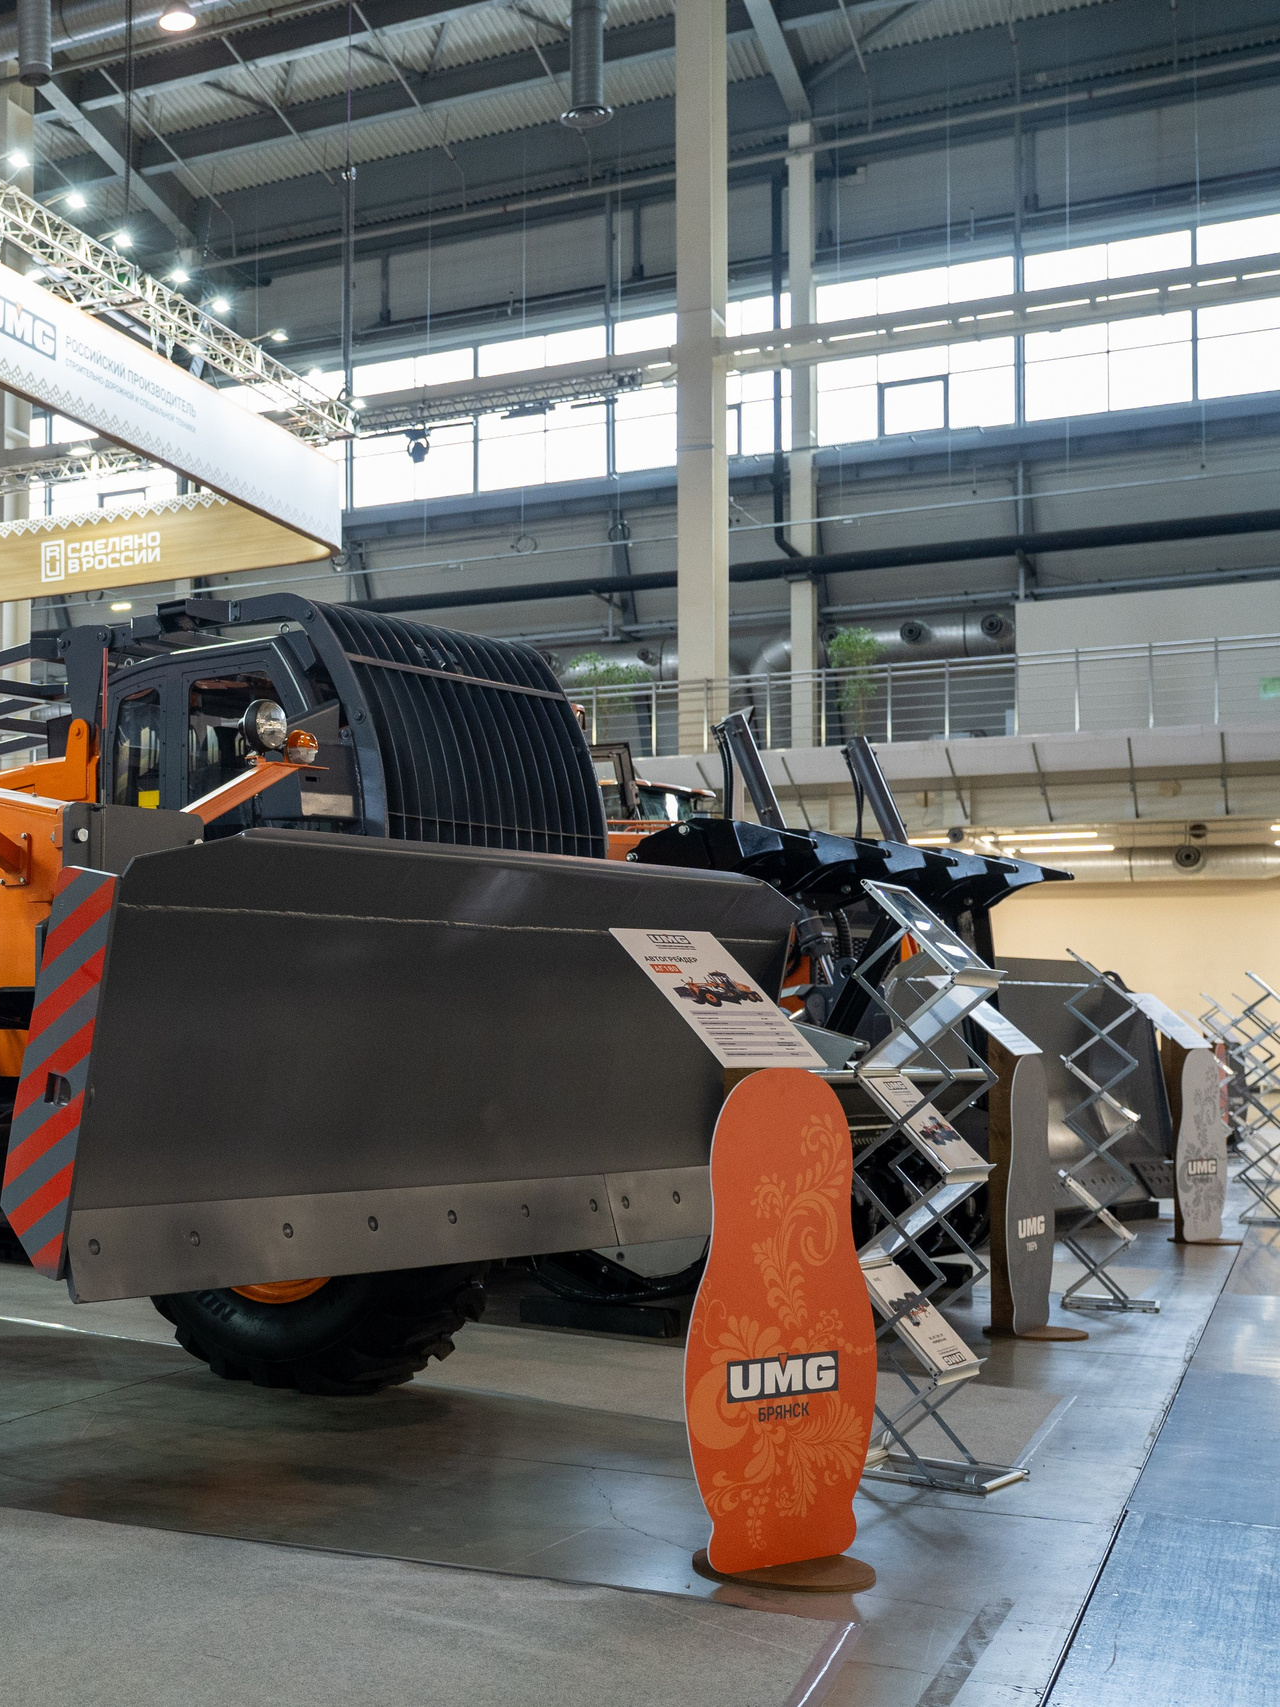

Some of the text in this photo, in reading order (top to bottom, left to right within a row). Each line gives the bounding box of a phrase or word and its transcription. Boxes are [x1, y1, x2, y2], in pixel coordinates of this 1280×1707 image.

[65, 335, 197, 418] РОССИЙСКИЙ ПРОИЗВОДИТЕЛЬ
[67, 531, 161, 558] СДЕЛАНО
[649, 934, 689, 944] UMG
[644, 955, 698, 964] АВТОГРЕЙДЕР
[1187, 1160, 1217, 1175] UMG
[1018, 1215, 1046, 1239] UMG
[729, 1354, 837, 1400] UMG
[757, 1402, 811, 1422] БРЯНСК
